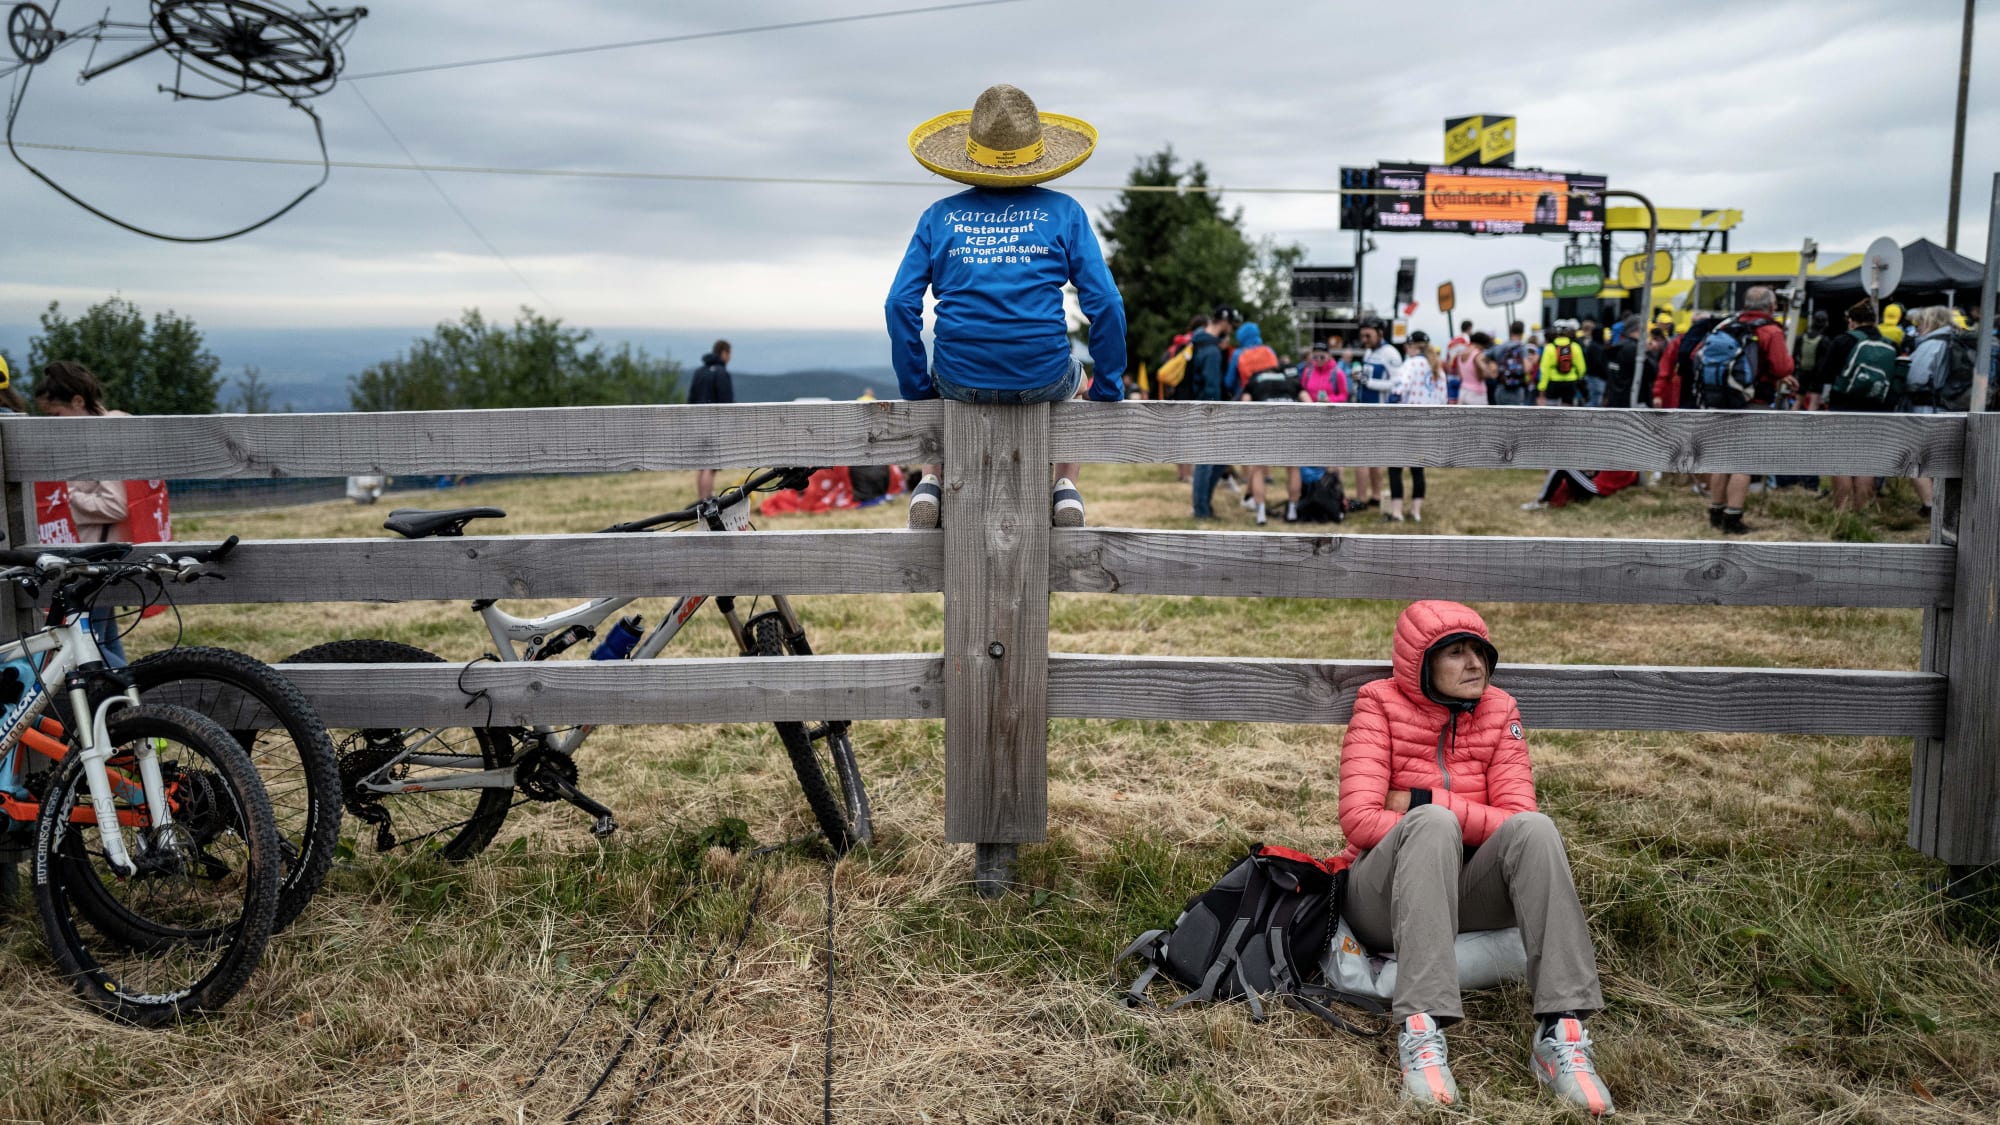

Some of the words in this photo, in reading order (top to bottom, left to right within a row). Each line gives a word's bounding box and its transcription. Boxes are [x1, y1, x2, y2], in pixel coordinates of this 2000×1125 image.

[944, 204, 1049, 226] Karadeniz
[954, 222, 1034, 235] Restaurant
[965, 235, 1020, 246] KEBAB
[948, 246, 971, 258] 70170
[973, 244, 1049, 256] PORT-SUR-SAÔNE
[962, 256, 975, 264] 03
[37, 519, 69, 540] UPER
[37, 816, 53, 886] HUTCHINSON
[289, 839, 314, 890] TOUGH
